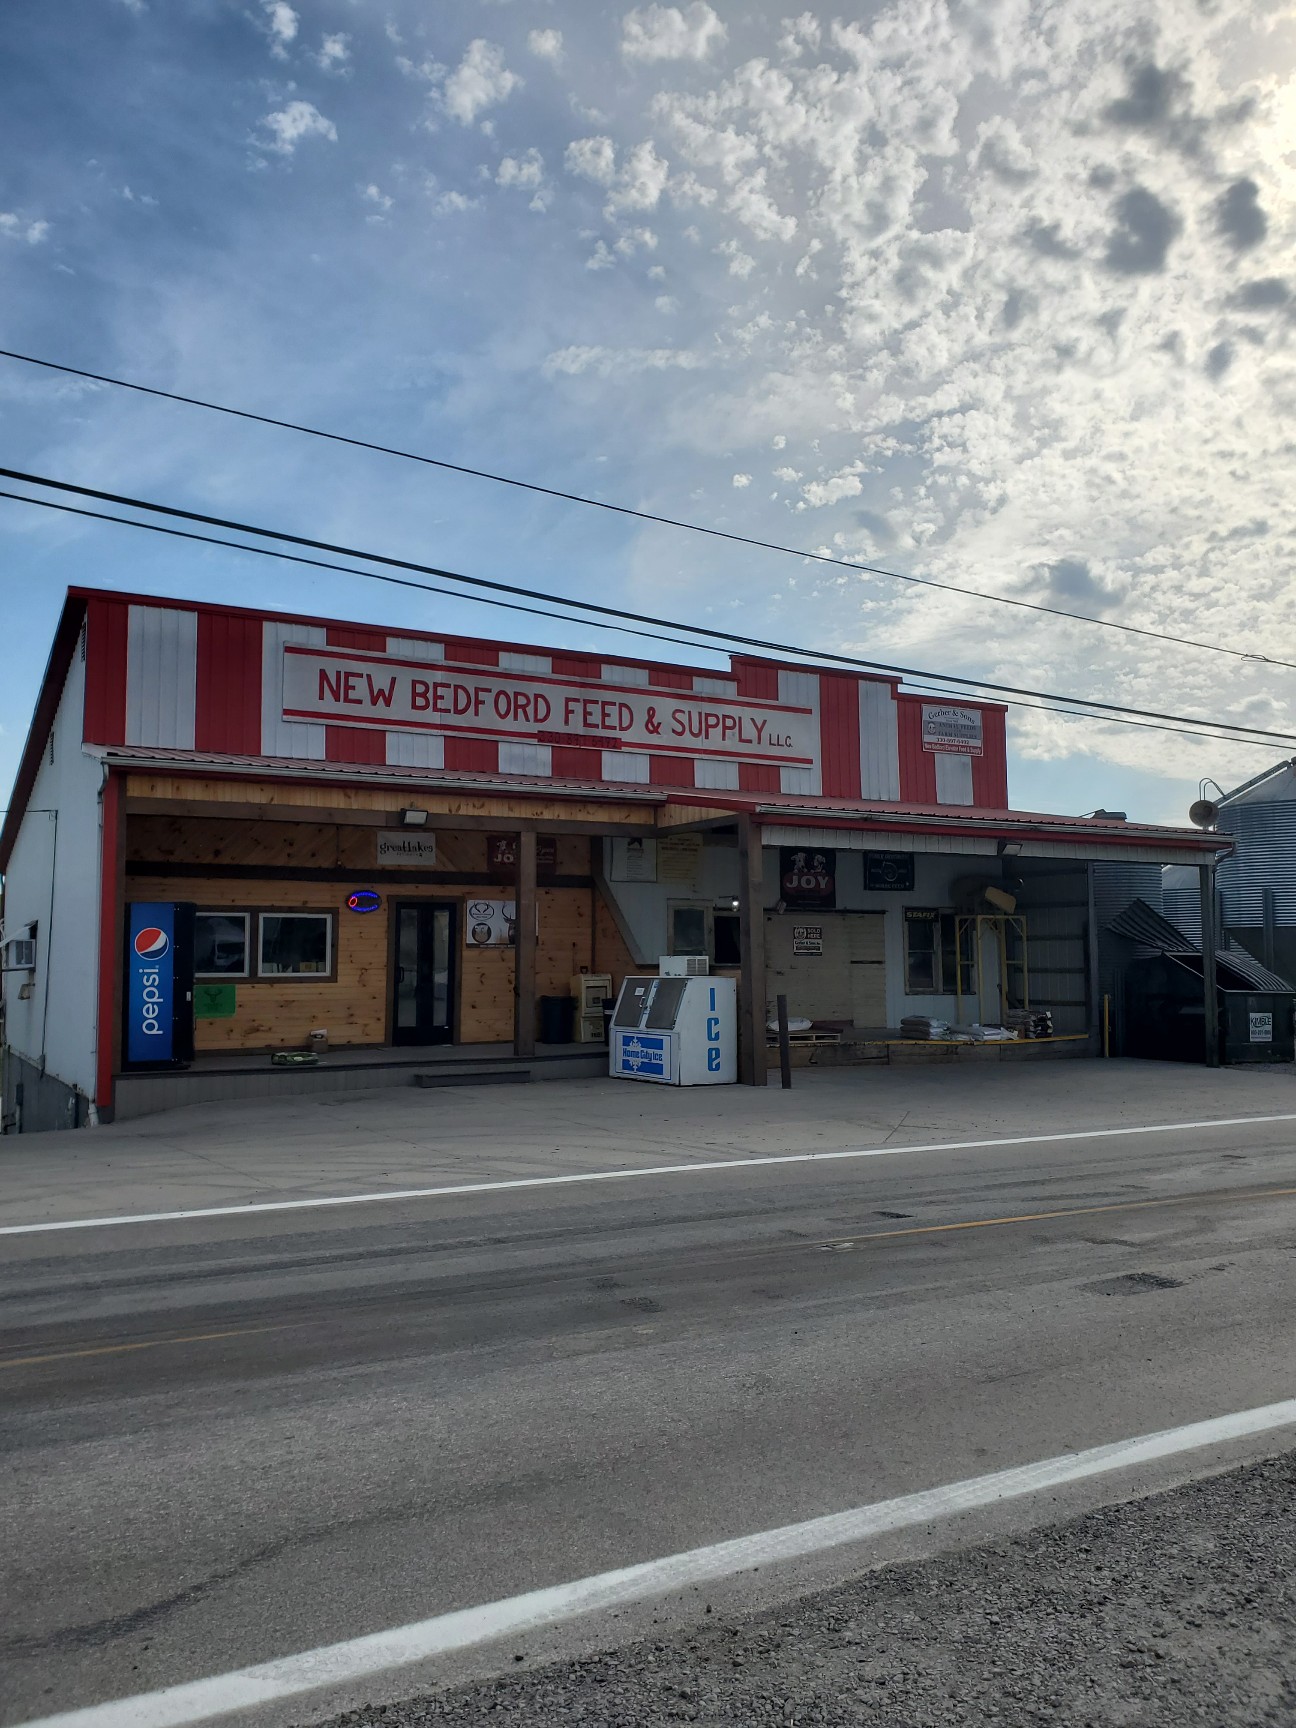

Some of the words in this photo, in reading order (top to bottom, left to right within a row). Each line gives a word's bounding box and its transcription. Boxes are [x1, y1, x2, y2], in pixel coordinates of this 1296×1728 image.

[318, 668, 397, 708] NEW
[411, 679, 551, 724] BEDFORD
[564, 697, 634, 732] FEED
[644, 706, 662, 736] &
[671, 708, 767, 745] SUPPLY
[928, 708, 950, 720] Gerber
[952, 709, 959, 717] &
[959, 711, 976, 725] Sons
[786, 875, 829, 889] JOY
[138, 969, 164, 1035] pepsi
[1251, 1017, 1271, 1026] KIMBLE
[622, 1047, 640, 1059] Home
[640, 1050, 652, 1061] City
[652, 1051, 663, 1062] Ice
